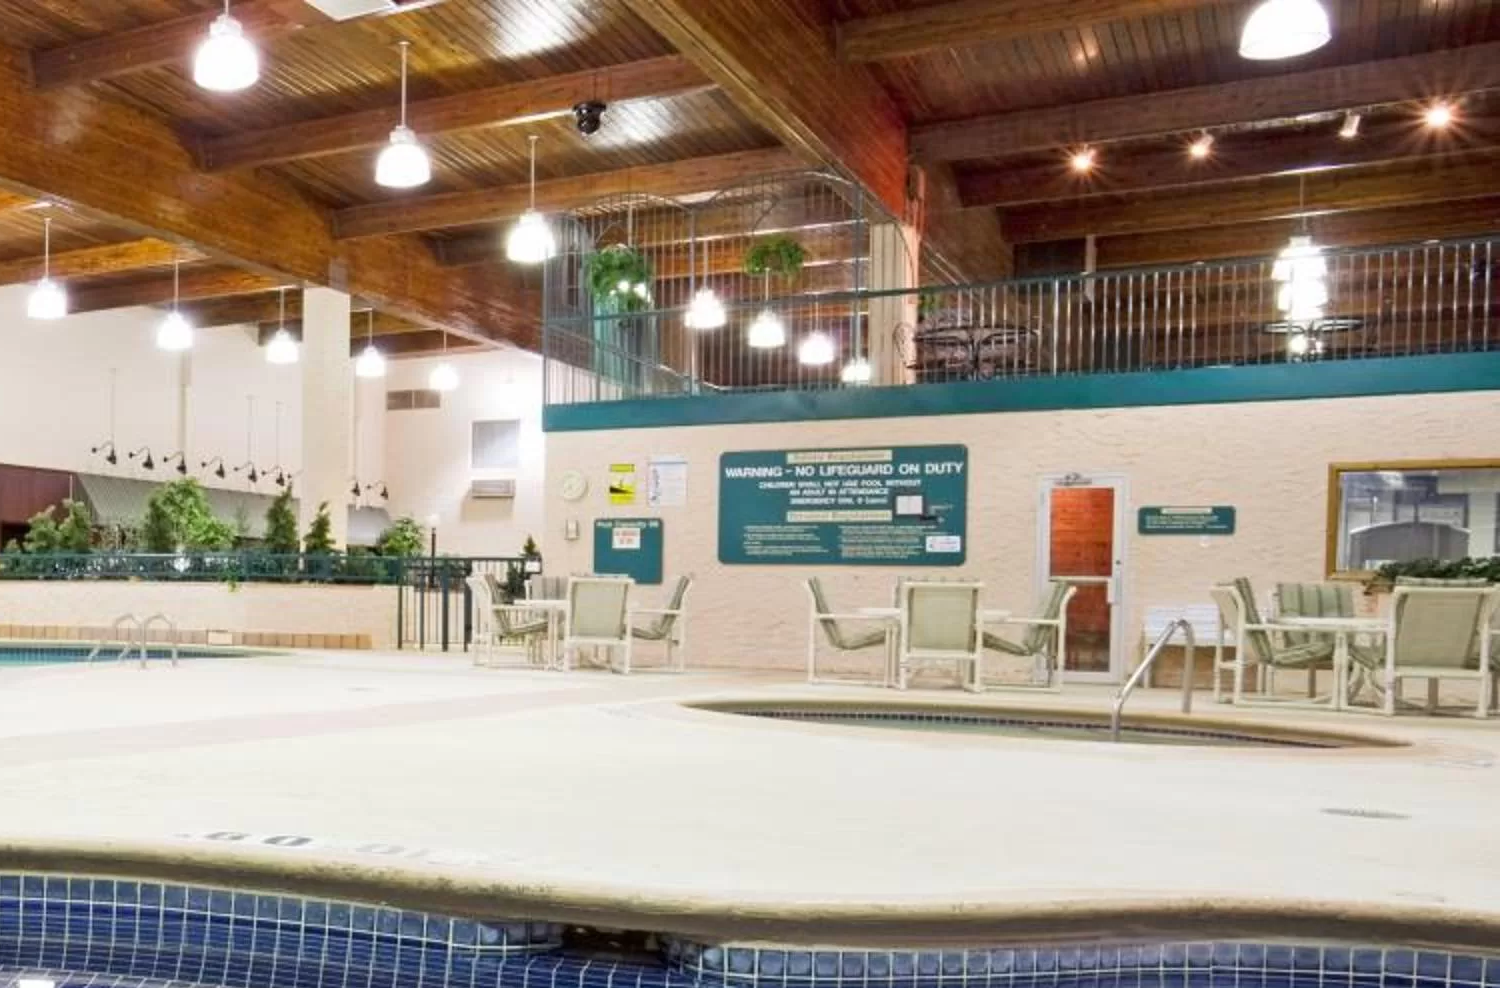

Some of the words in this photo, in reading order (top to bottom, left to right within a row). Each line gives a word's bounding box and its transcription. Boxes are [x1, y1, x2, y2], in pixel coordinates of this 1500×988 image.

[725, 465, 783, 478] WARNING
[795, 465, 814, 476] NO
[819, 463, 893, 476] LIFEGUARD
[898, 463, 920, 474] ON
[925, 461, 964, 474] DUTY
[758, 481, 795, 489] CHILDREN
[861, 479, 882, 487] POOL
